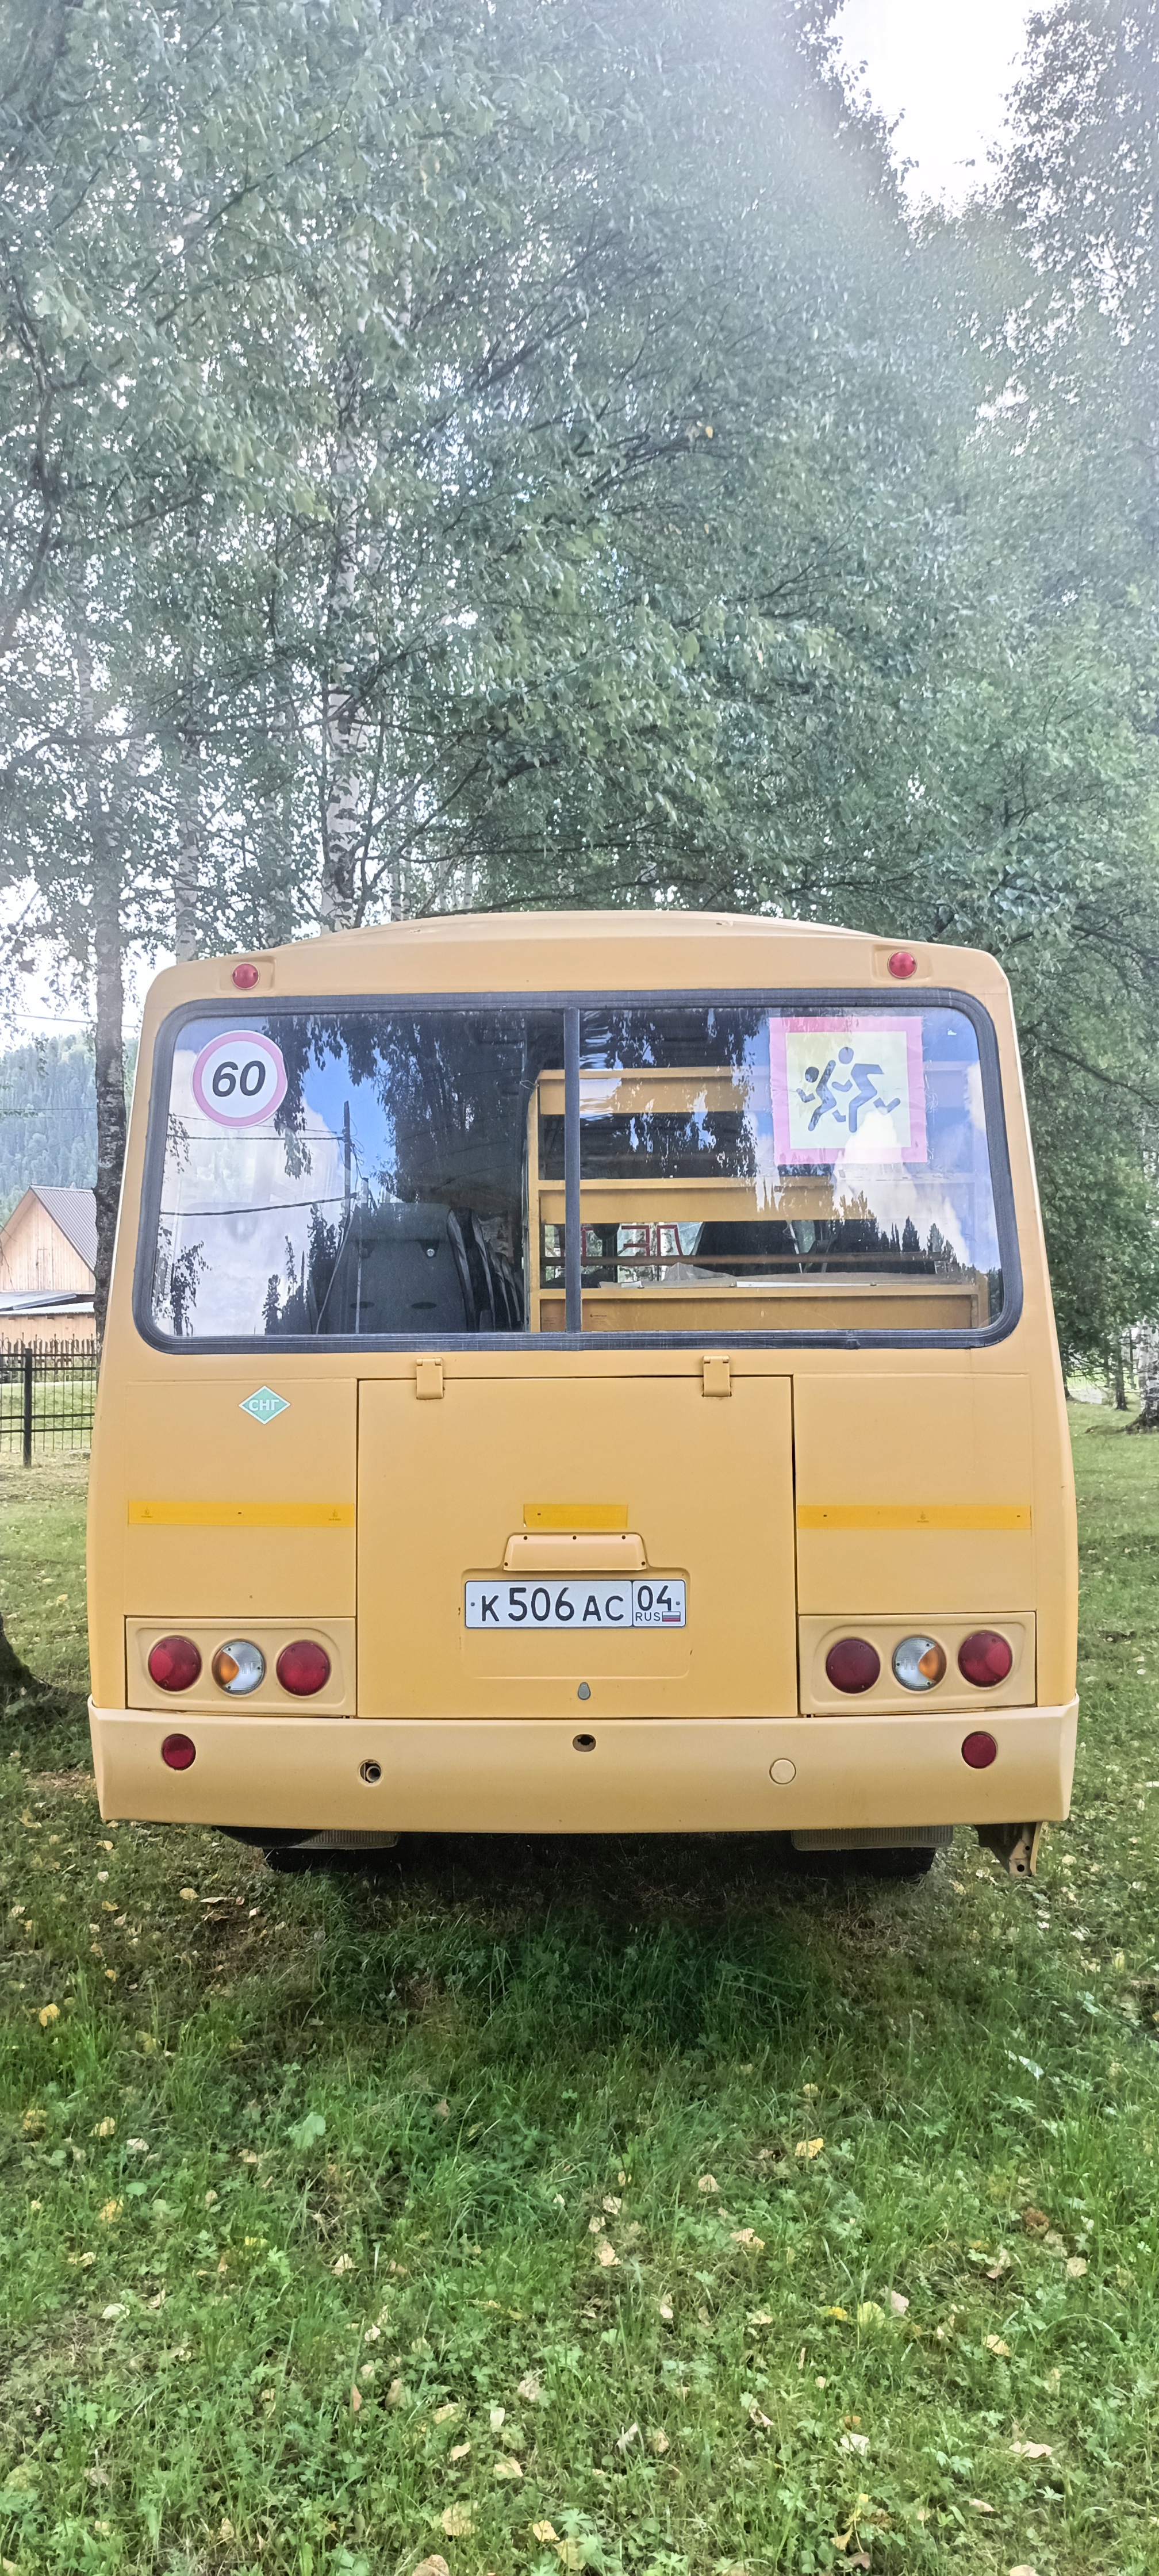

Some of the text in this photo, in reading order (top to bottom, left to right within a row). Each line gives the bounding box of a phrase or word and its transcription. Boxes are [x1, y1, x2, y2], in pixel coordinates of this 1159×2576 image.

[213, 1060, 266, 1097] 60
[248, 1399, 279, 1411] СНГ
[638, 1585, 671, 1611] 04
[635, 1612, 661, 1621] RUS
